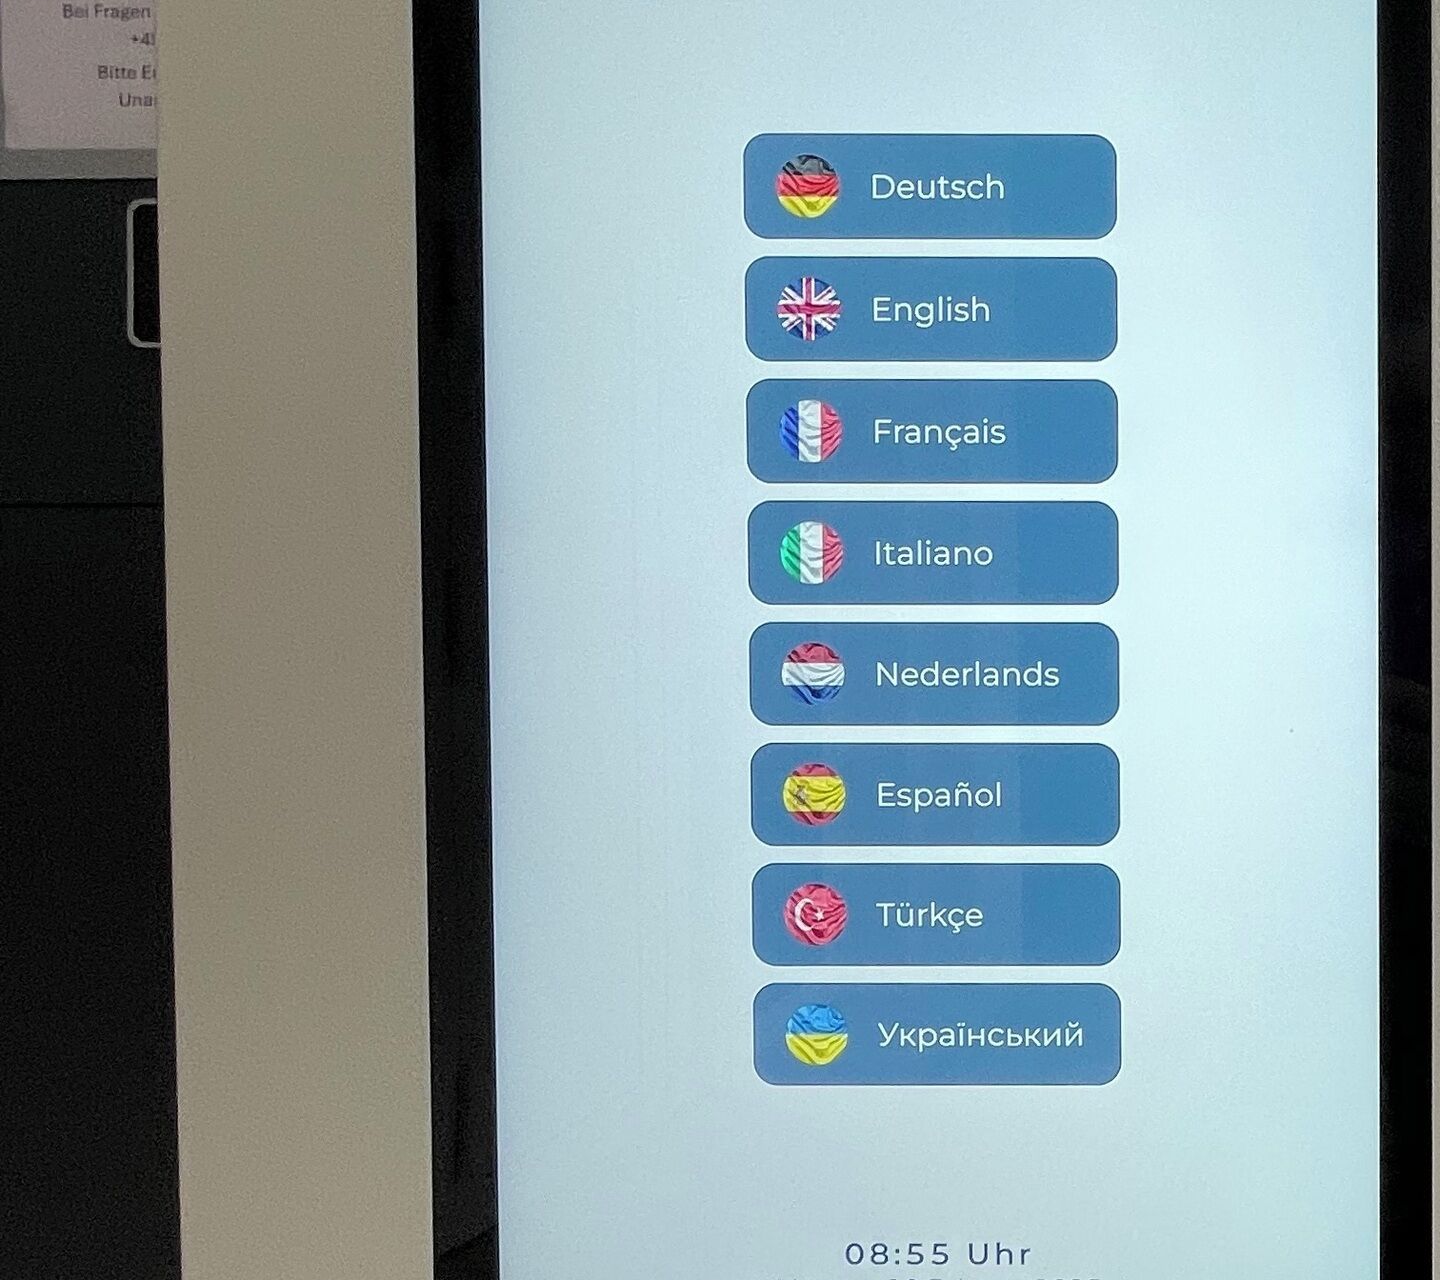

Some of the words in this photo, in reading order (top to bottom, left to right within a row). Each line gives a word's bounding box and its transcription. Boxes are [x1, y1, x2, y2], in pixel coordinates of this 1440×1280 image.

[62, 3, 89, 19] Bei
[94, 3, 151, 22] Fragen
[98, 65, 137, 80] Bitte
[119, 93, 157, 108] Una
[871, 173, 1005, 200] Deutsch
[872, 296, 991, 329] English
[873, 419, 1006, 451] Français
[874, 540, 994, 566] Italiano
[875, 661, 1060, 687] Nederlands
[877, 782, 1002, 813] Español
[875, 901, 983, 933] Türkçe
[877, 1021, 1084, 1048] Український
[845, 1242, 950, 1265] 08:55
[968, 1242, 1031, 1265] Uhr
